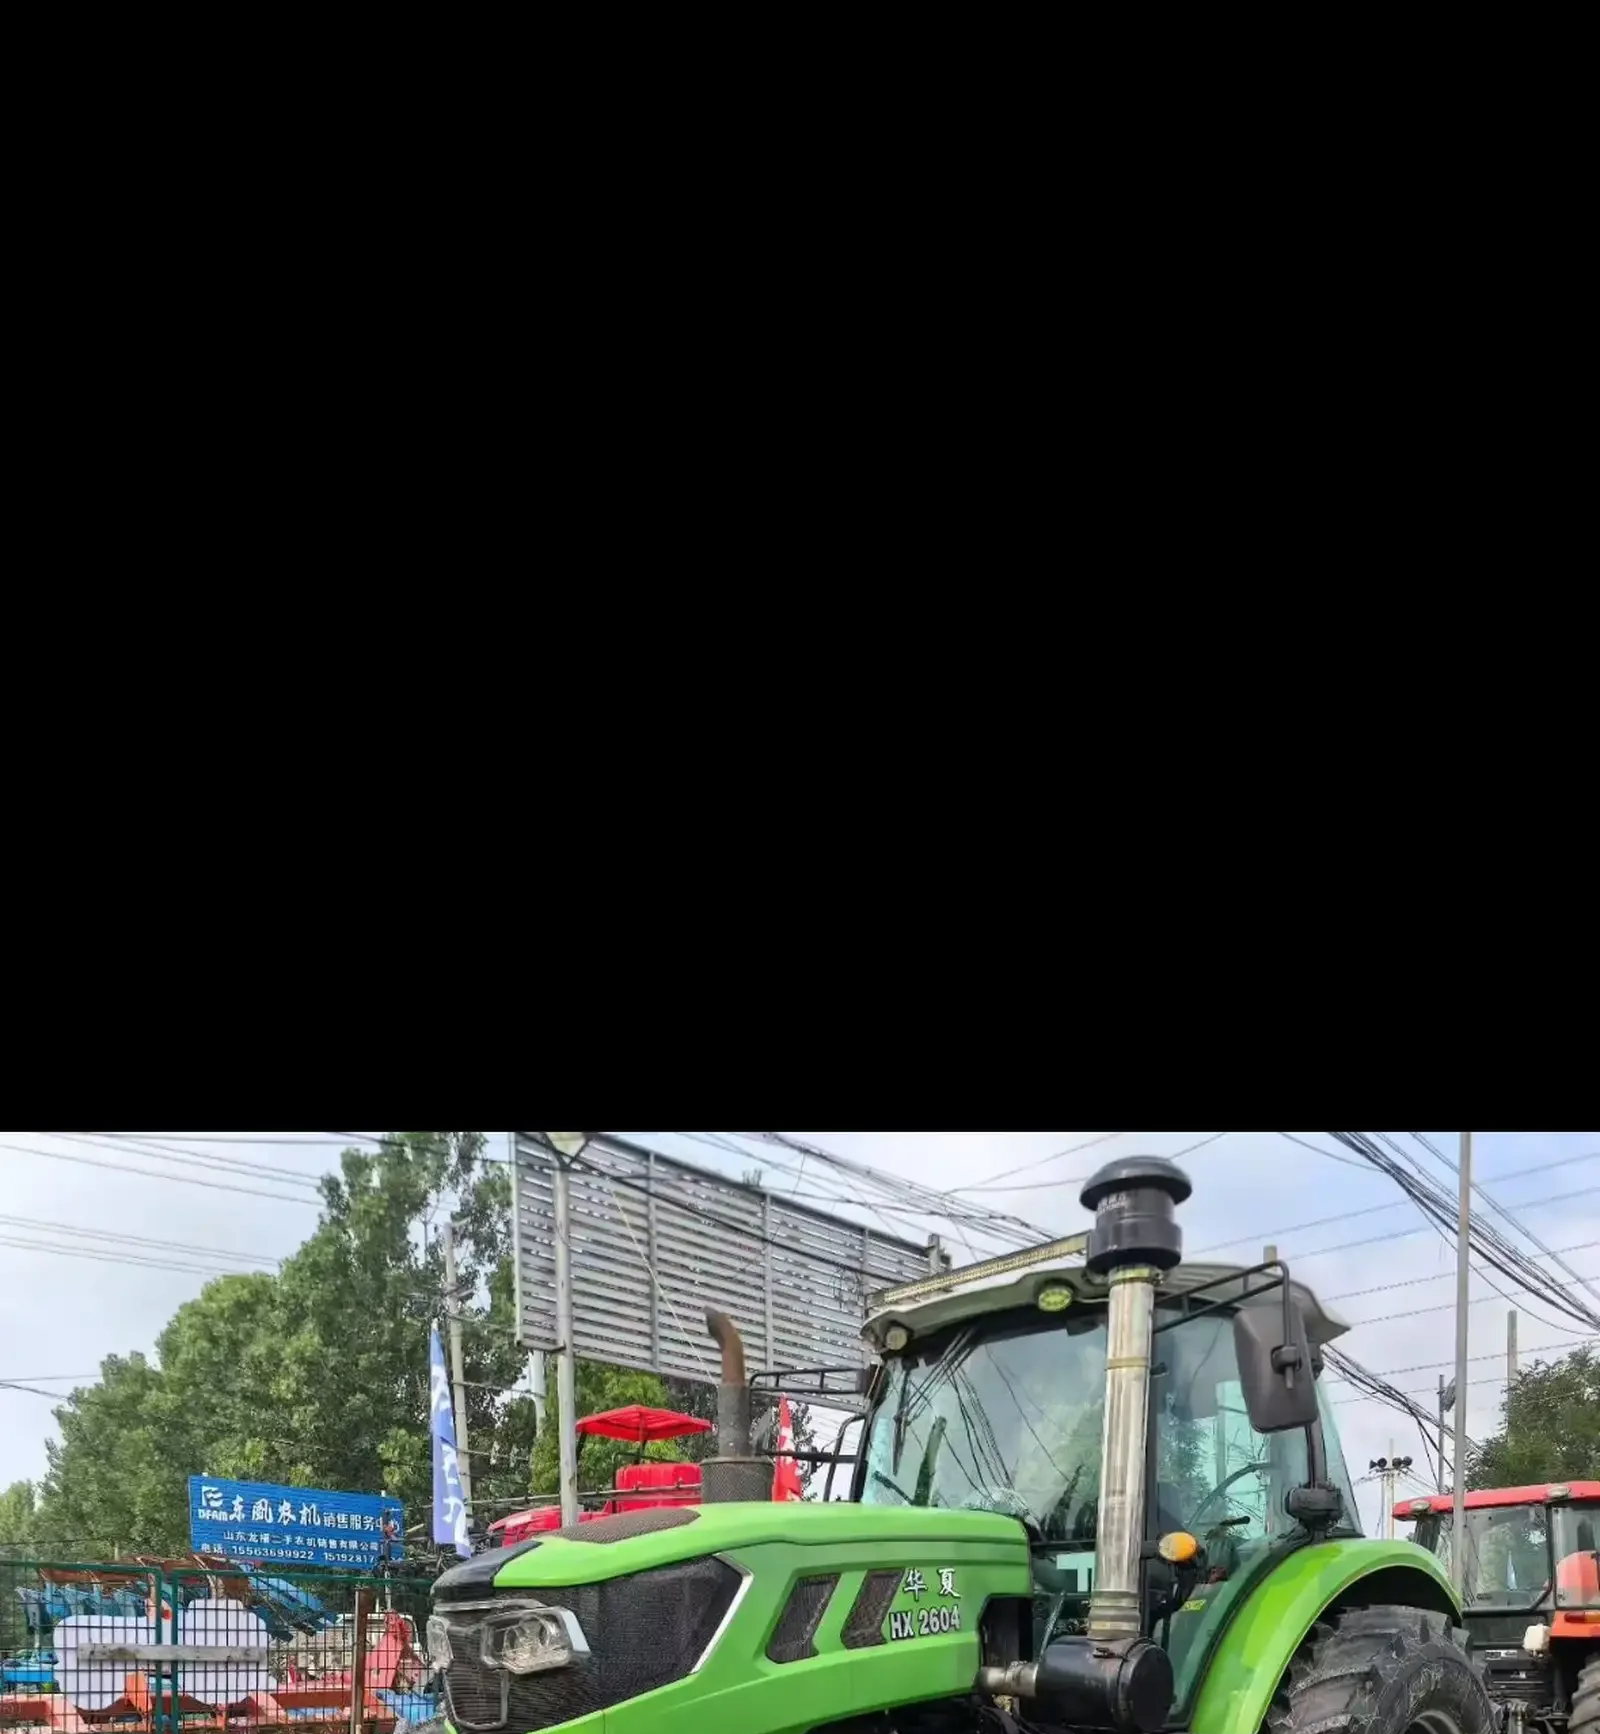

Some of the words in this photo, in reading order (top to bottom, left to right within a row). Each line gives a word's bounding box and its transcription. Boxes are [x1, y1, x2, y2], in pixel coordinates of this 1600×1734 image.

[198, 1508, 228, 1522] DFAM
[904, 1567, 961, 1601] 华夏
[890, 1611, 914, 1640] HX
[919, 1604, 960, 1635] 2604
